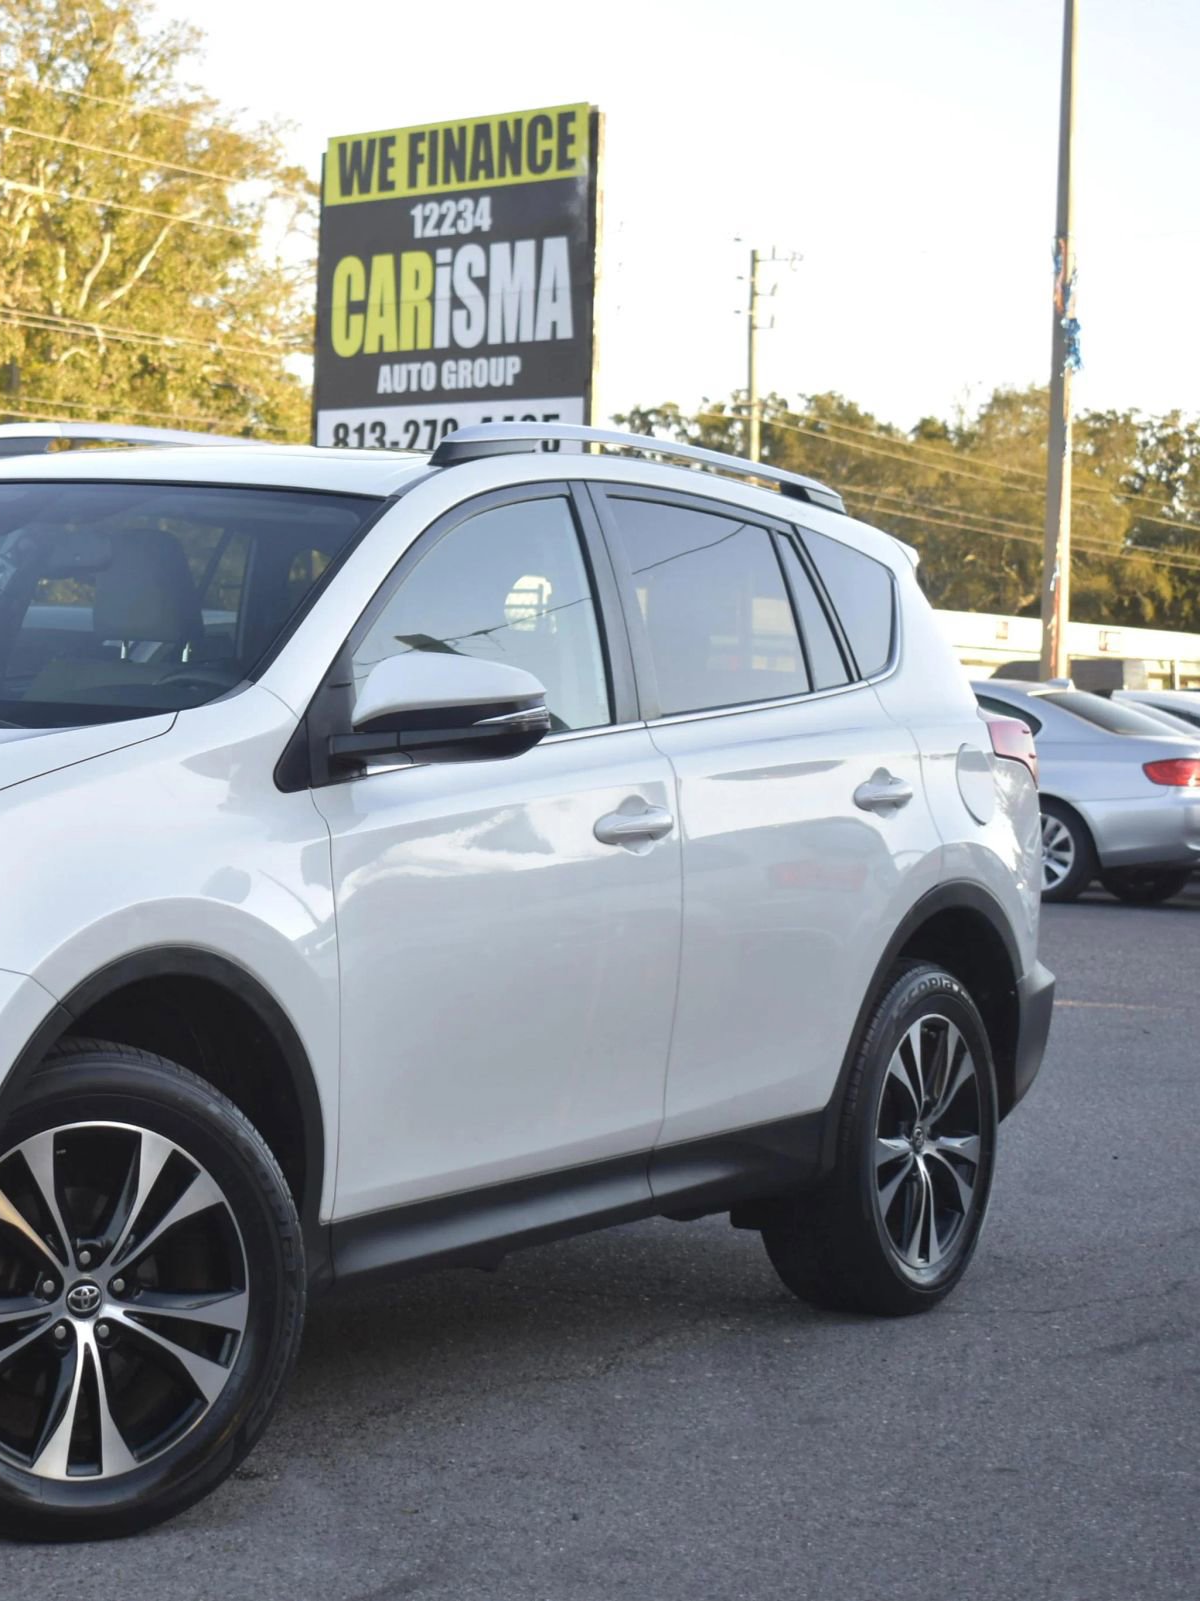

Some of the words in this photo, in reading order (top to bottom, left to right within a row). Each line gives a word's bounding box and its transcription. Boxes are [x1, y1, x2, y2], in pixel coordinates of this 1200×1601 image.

[337, 135, 397, 198] WE
[407, 110, 577, 190] FINANCE
[410, 195, 493, 239] 12234
[377, 360, 437, 394] AUTO
[441, 355, 522, 389] GROUP
